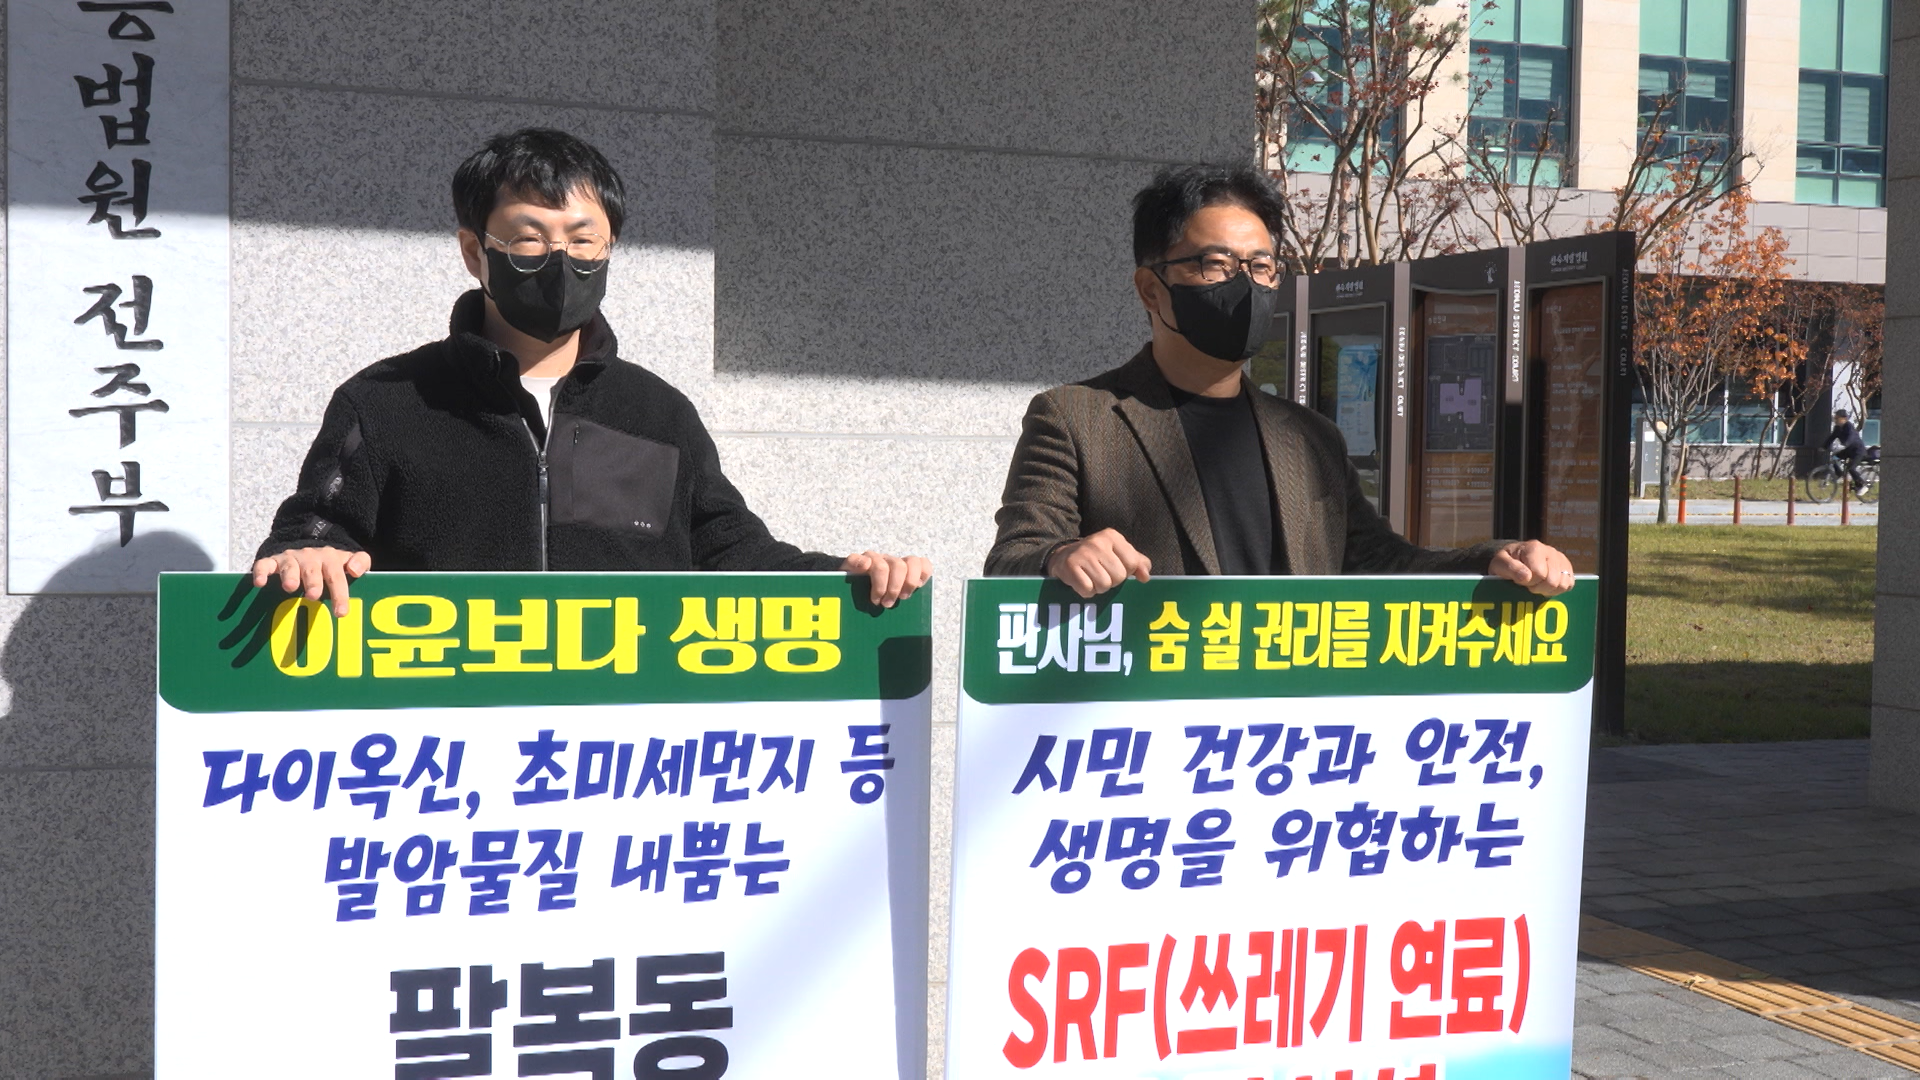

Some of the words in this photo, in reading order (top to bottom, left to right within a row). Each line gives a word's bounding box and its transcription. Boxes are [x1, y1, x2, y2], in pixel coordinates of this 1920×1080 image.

[69, 274, 170, 547] 전주부
[270, 596, 645, 677] 이윤보다
[670, 597, 840, 673] 생명
[997, 603, 1132, 676] 판사님,
[1149, 602, 1189, 671] 숨
[1201, 602, 1241, 670] 쉴
[1253, 602, 1369, 669] 권리를
[1379, 600, 1568, 667] 지켜주세요
[203, 734, 479, 819] 다이옥신,
[514, 730, 814, 805] 초미세먼지
[841, 725, 894, 803] 등
[1012, 728, 1151, 797] 시민
[1184, 724, 1375, 795] 건강과
[1406, 719, 1542, 789] 안전,
[326, 830, 583, 921] 발암물질
[612, 822, 789, 901] 내뿜는
[1030, 810, 1235, 893] 생명을
[1266, 803, 1523, 877] 위협하는
[390, 952, 732, 1080] 팔복동
[1003, 925, 1367, 1069] SRF(쓰레기
[1390, 915, 1530, 1039] 연료)
